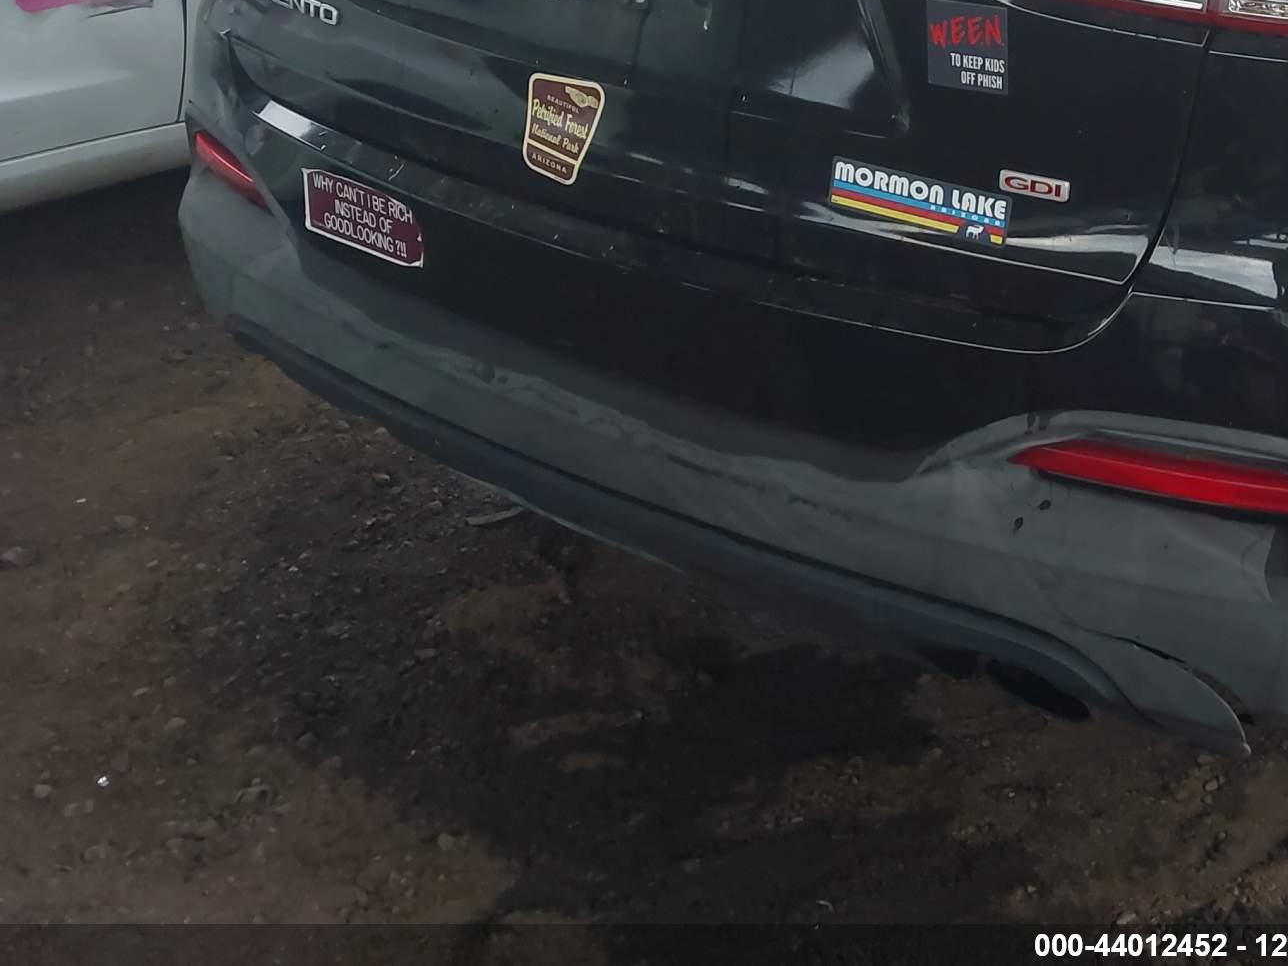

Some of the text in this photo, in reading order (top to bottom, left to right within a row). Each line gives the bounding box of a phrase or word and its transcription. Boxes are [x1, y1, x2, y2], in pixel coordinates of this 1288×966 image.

[929, 14, 1005, 49] WEEN
[950, 52, 1006, 74] TO KEEP KIDS
[960, 70, 1003, 90] OFF PHISH
[565, 114, 589, 139] Forest
[562, 138, 579, 153] Park
[532, 154, 567, 173] ARIZONA
[312, 172, 333, 193] WHY
[335, 181, 366, 206] CAN'T
[372, 195, 387, 215] BE
[388, 201, 413, 225] RICH
[834, 161, 1007, 220] MORMON LAKE
[1004, 176, 1062, 197] GDI
[334, 199, 393, 233] INSTEAD OF
[323, 212, 394, 253] GOODLOOKING
